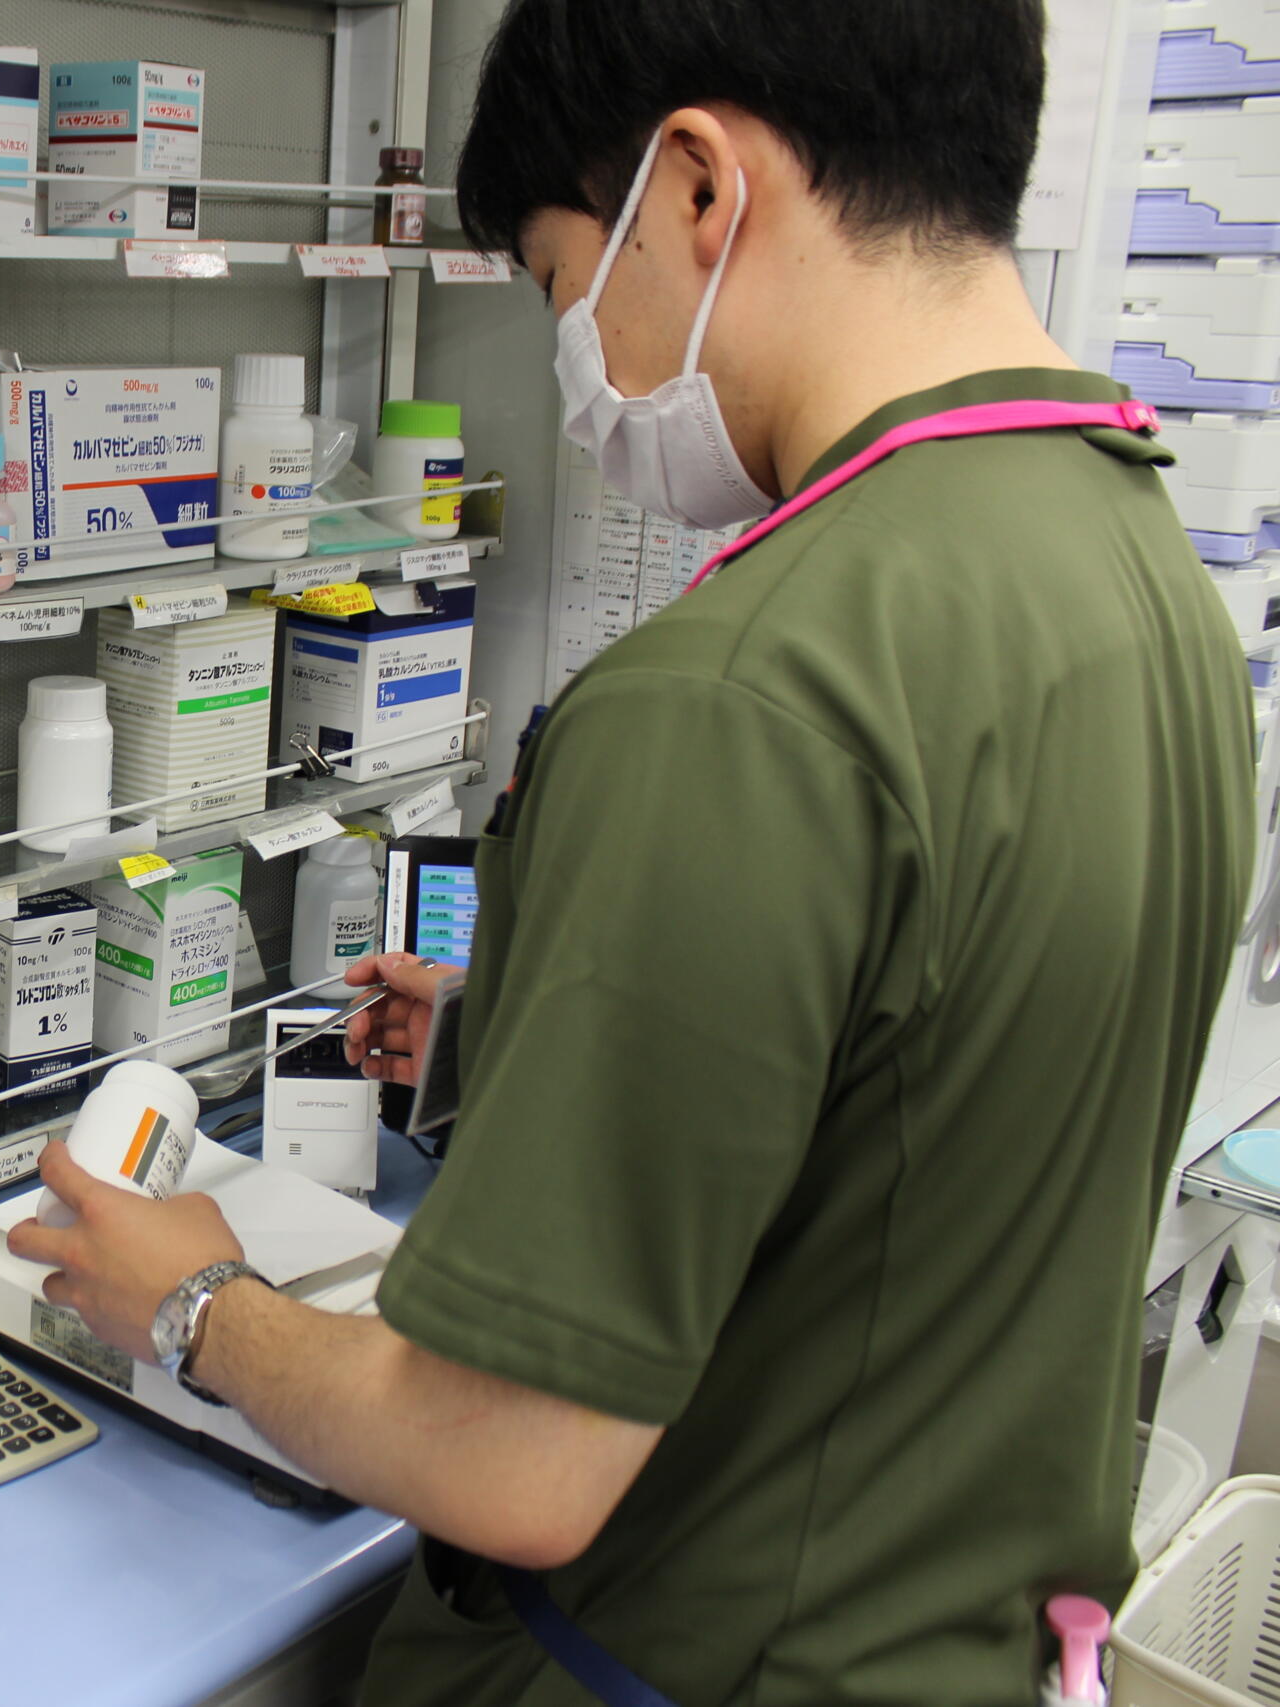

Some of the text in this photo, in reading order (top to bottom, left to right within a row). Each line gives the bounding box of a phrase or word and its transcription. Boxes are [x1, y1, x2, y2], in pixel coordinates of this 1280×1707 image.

[123, 379, 158, 393] 500mg/g
[195, 378, 214, 391] 100g
[9, 380, 22, 425] 500mg/g
[87, 507, 134, 534] 50%
[19, 622, 51, 632] 100mg/g
[171, 872, 188, 883] meiji
[74, 947, 92, 957] 100g
[180, 941, 222, 963] ホスミシン
[18, 955, 48, 966] 10mg/1g
[38, 1012, 67, 1036] 1%
[133, 1031, 147, 1044] 100
[297, 1100, 348, 1109] OPTICON
